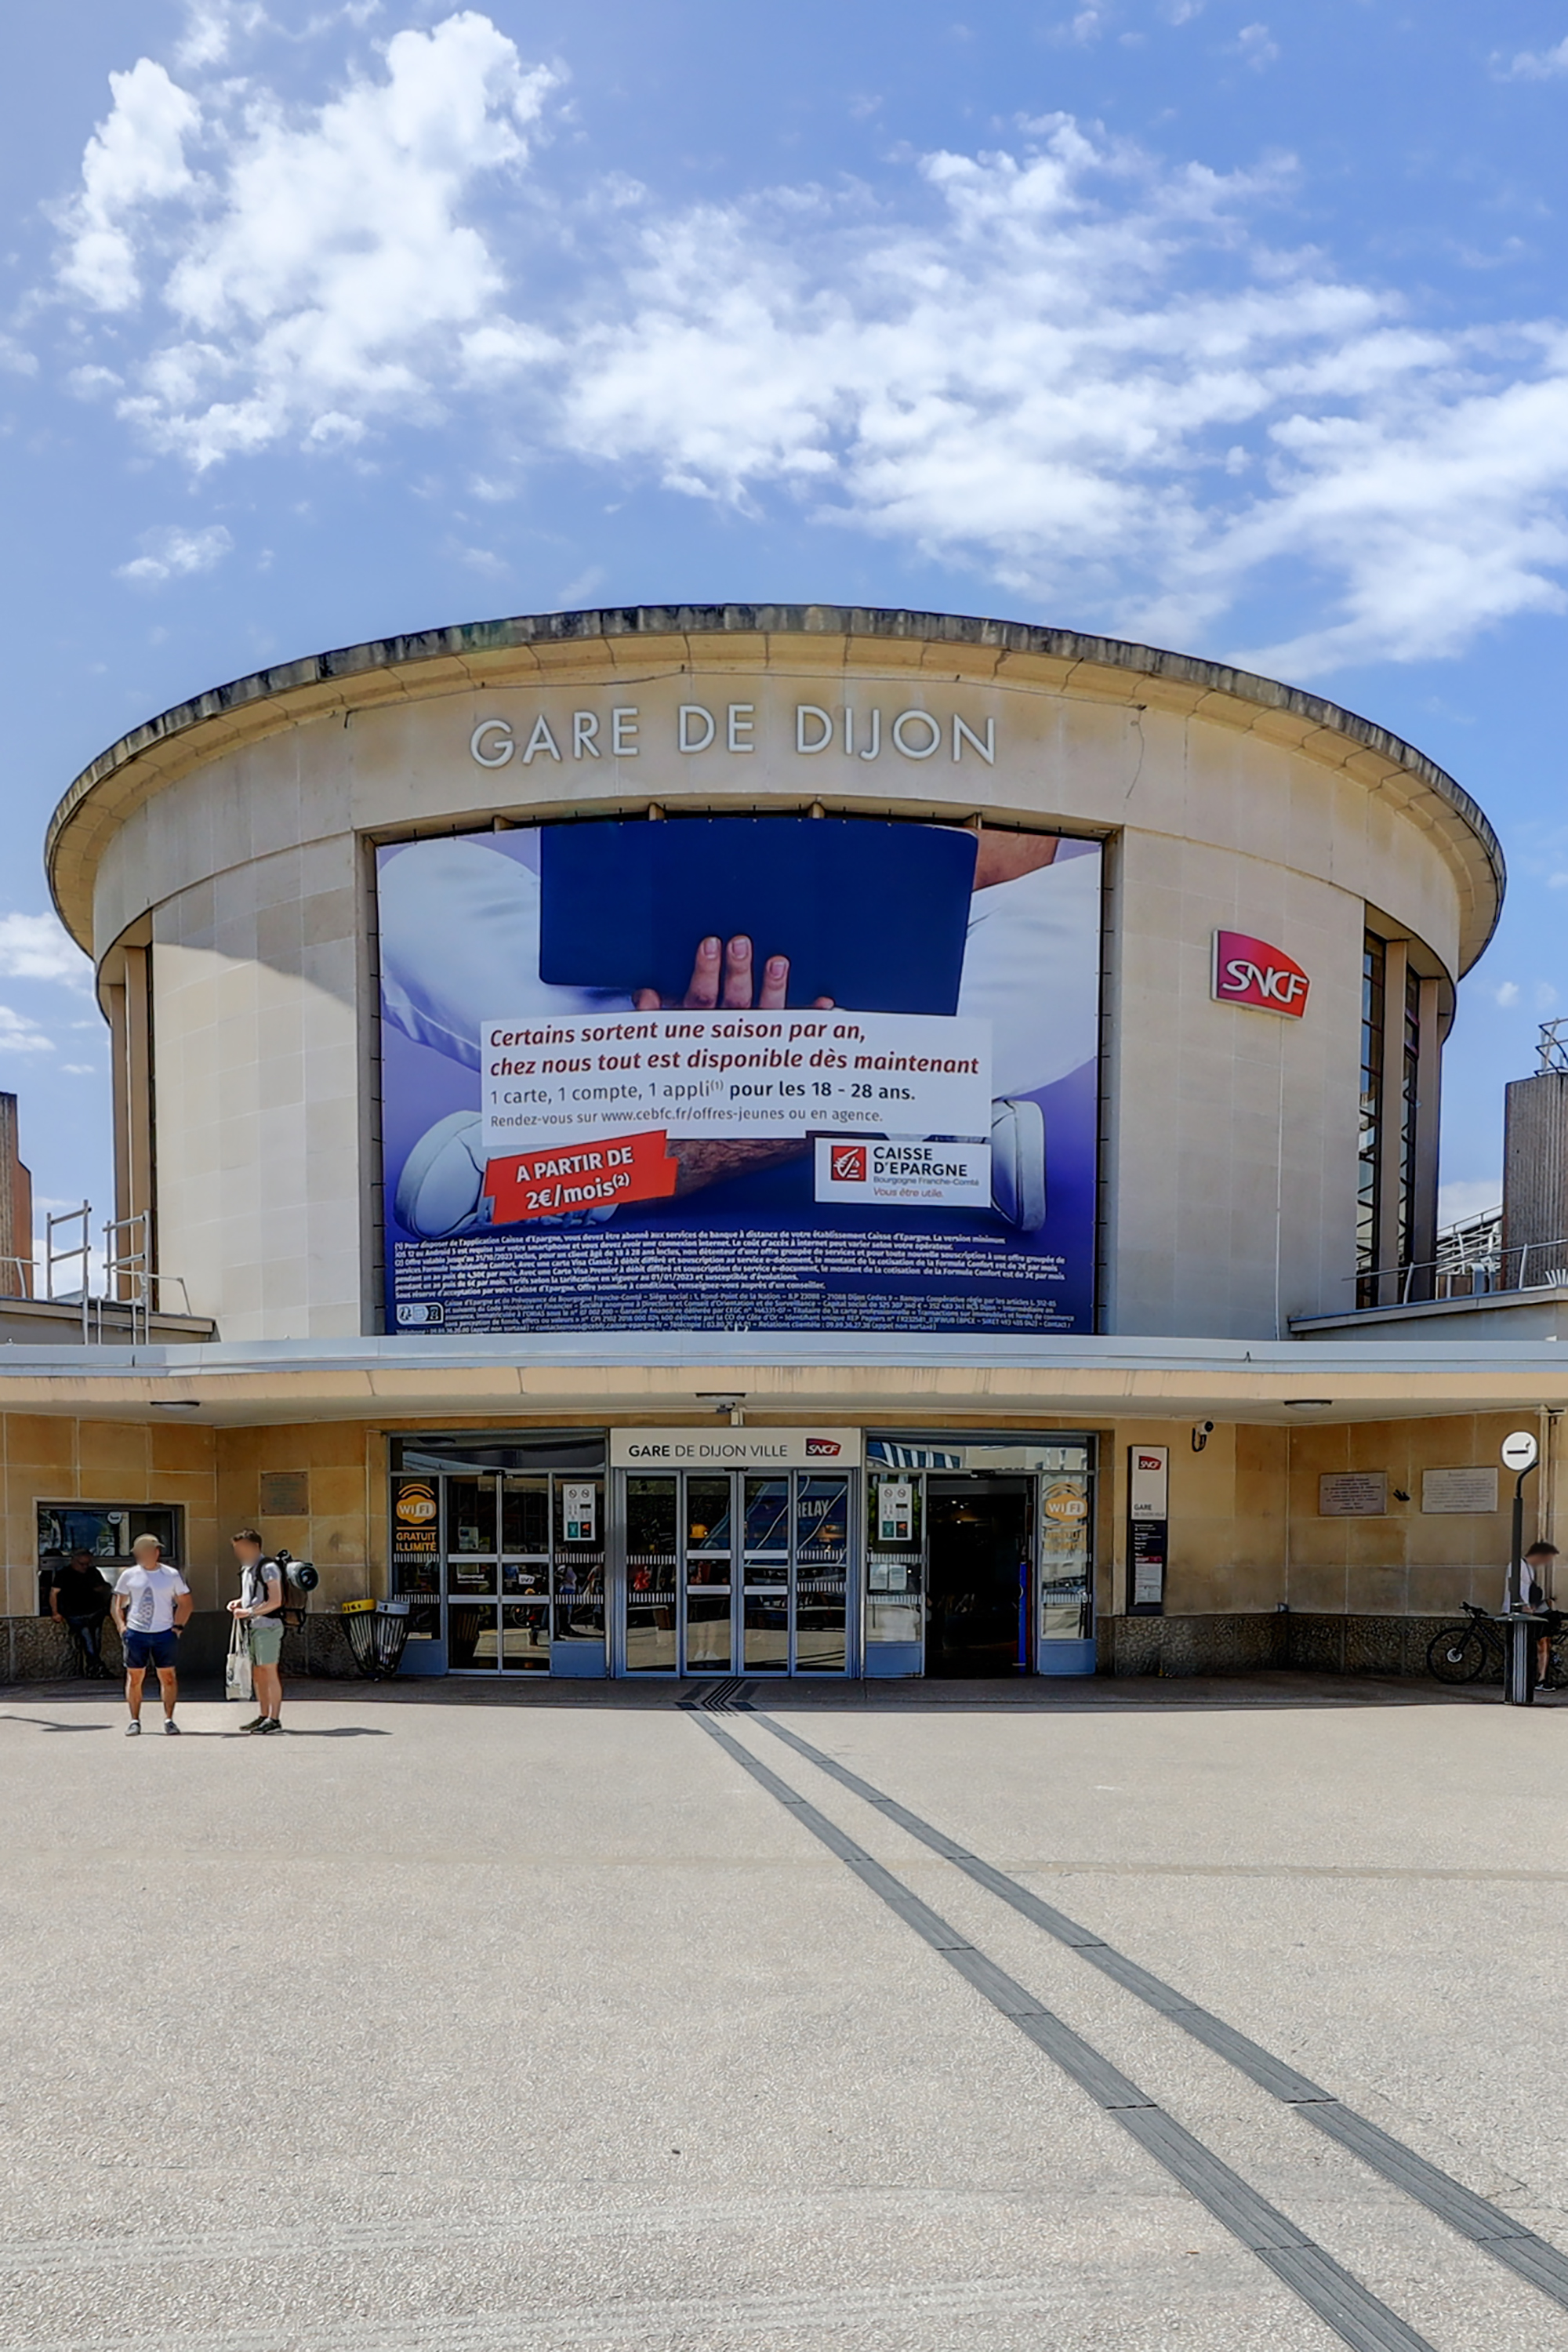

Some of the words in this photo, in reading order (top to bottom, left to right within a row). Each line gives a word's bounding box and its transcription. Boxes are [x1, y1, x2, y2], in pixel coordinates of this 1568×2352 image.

[470, 707, 640, 768] GARE
[679, 704, 754, 753] DE
[797, 705, 995, 766] DIJON
[1221, 960, 1308, 1003] SNCF
[490, 1025, 575, 1047] Certains
[581, 1022, 659, 1041] sortent
[666, 1023, 705, 1038] une
[710, 1018, 782, 1038] saison
[789, 1023, 828, 1042] par
[833, 1025, 866, 1044] an,
[490, 1058, 535, 1076] chez
[542, 1058, 591, 1074] nous
[598, 1054, 641, 1071] tout
[647, 1051, 681, 1068] est
[687, 1048, 804, 1073] disponible
[809, 1048, 848, 1069] dès
[853, 1051, 979, 1074] maintenant
[491, 1091, 498, 1104] 1
[503, 1089, 553, 1105] carte,
[557, 1087, 565, 1101] 1
[572, 1085, 643, 1103] compte,
[648, 1083, 656, 1097] 1
[730, 1083, 774, 1100] pour
[779, 1081, 805, 1097] les
[811, 1082, 832, 1096] 18
[851, 1083, 873, 1098] 28
[879, 1087, 916, 1100] ans.
[491, 1114, 573, 1127] Rendez-vous
[577, 1112, 597, 1123] sur
[601, 1106, 784, 1123] www.cebfc.fr/offres-jeunes
[789, 1109, 806, 1120] ou
[811, 1109, 828, 1120] en
[832, 1109, 883, 1123] agence.
[873, 1146, 933, 1160] CAISSE
[516, 1165, 532, 1183] A
[534, 1152, 604, 1179] PARTIR
[607, 1146, 633, 1167] DE
[874, 1162, 968, 1177] D'EPARGNE
[873, 1177, 916, 1185] Bourgogne
[918, 1178, 979, 1186] Franche-Comté
[899, 1187, 920, 1197] être
[921, 1189, 943, 1197] utile.
[501, 1235, 524, 1243] Caisse
[781, 1247, 811, 1256] groupée
[941, 1250, 985, 1259] souscription
[1007, 1253, 1025, 1261] offre
[651, 1273, 693, 1282] 01/01/2023
[706, 1272, 747, 1281] susceptible
[677, 1281, 739, 1290] renseignez-vous
[629, 1444, 670, 1457] GARE
[674, 1444, 695, 1457] DE
[699, 1444, 746, 1457] DIJON
[750, 1444, 788, 1457] VILLE
[807, 1445, 837, 1454] SNCF
[396, 1532, 437, 1541] GRATUIT
